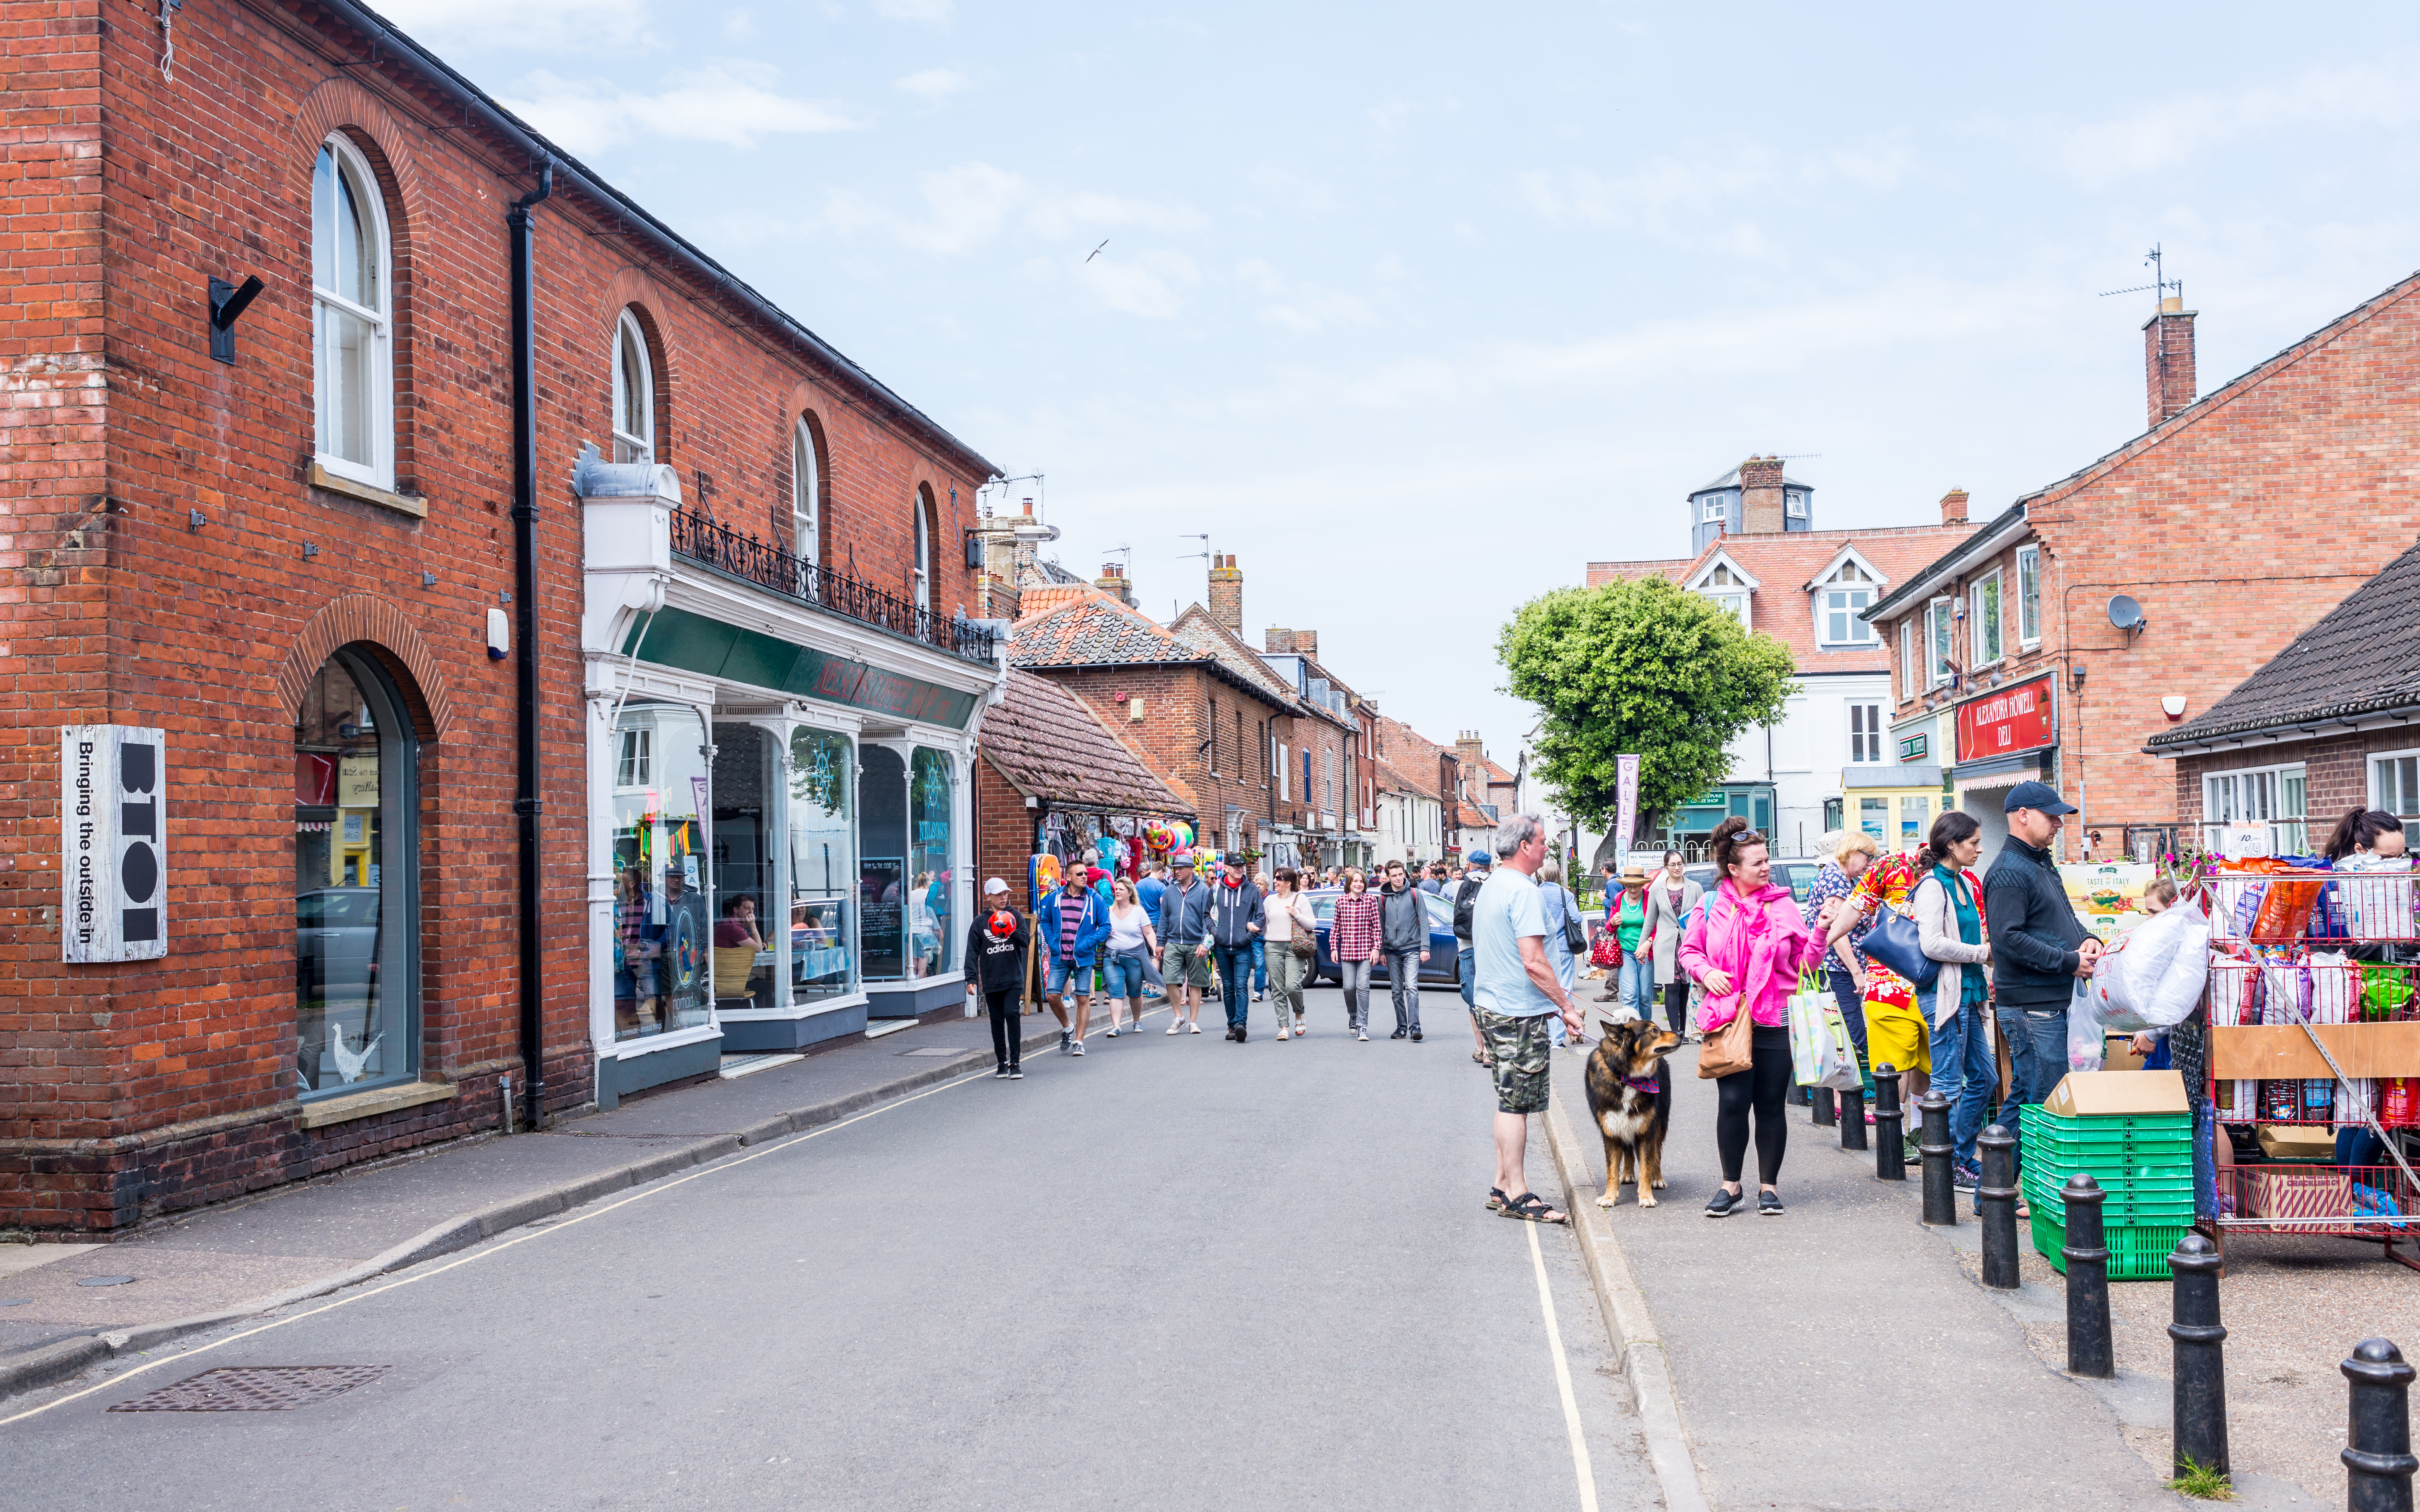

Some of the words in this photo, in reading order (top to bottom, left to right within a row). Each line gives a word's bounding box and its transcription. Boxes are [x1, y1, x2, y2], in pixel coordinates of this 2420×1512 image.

[865, 674, 913, 712] COFFEE
[905, 685, 940, 717] SHOP
[1976, 698, 2008, 726] ALEXANDRA
[2009, 691, 2035, 717] HOWELL
[1912, 738, 1924, 753] DUFFEY
[1998, 725, 2011, 747] DELI
[76, 742, 93, 816] Bringing
[1620, 761, 1633, 839] GALLE
[79, 822, 94, 850] the
[79, 855, 95, 924] outside
[79, 928, 94, 944] in
[987, 943, 1015, 955] adidas
[673, 992, 693, 1011] nomad
[621, 1027, 639, 1037] homeware
